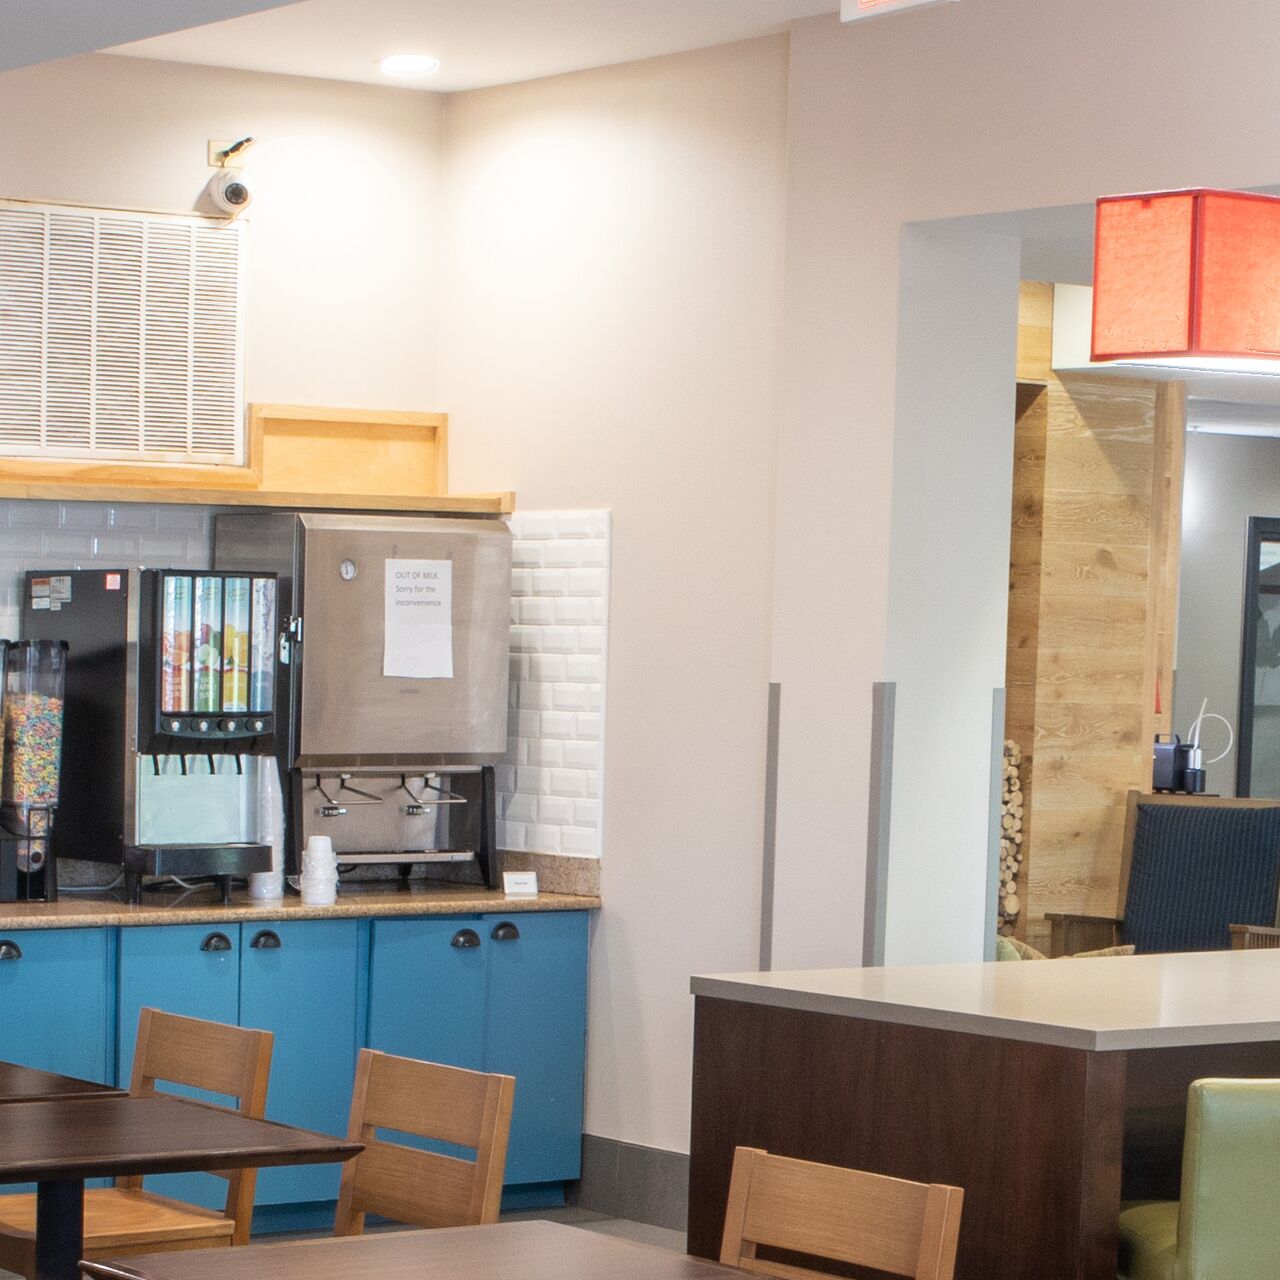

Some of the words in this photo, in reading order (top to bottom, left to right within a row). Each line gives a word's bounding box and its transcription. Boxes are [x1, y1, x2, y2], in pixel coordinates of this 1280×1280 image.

[395, 571, 410, 579] OUT
[412, 571, 421, 579] OF
[395, 585, 413, 594] Sorry
